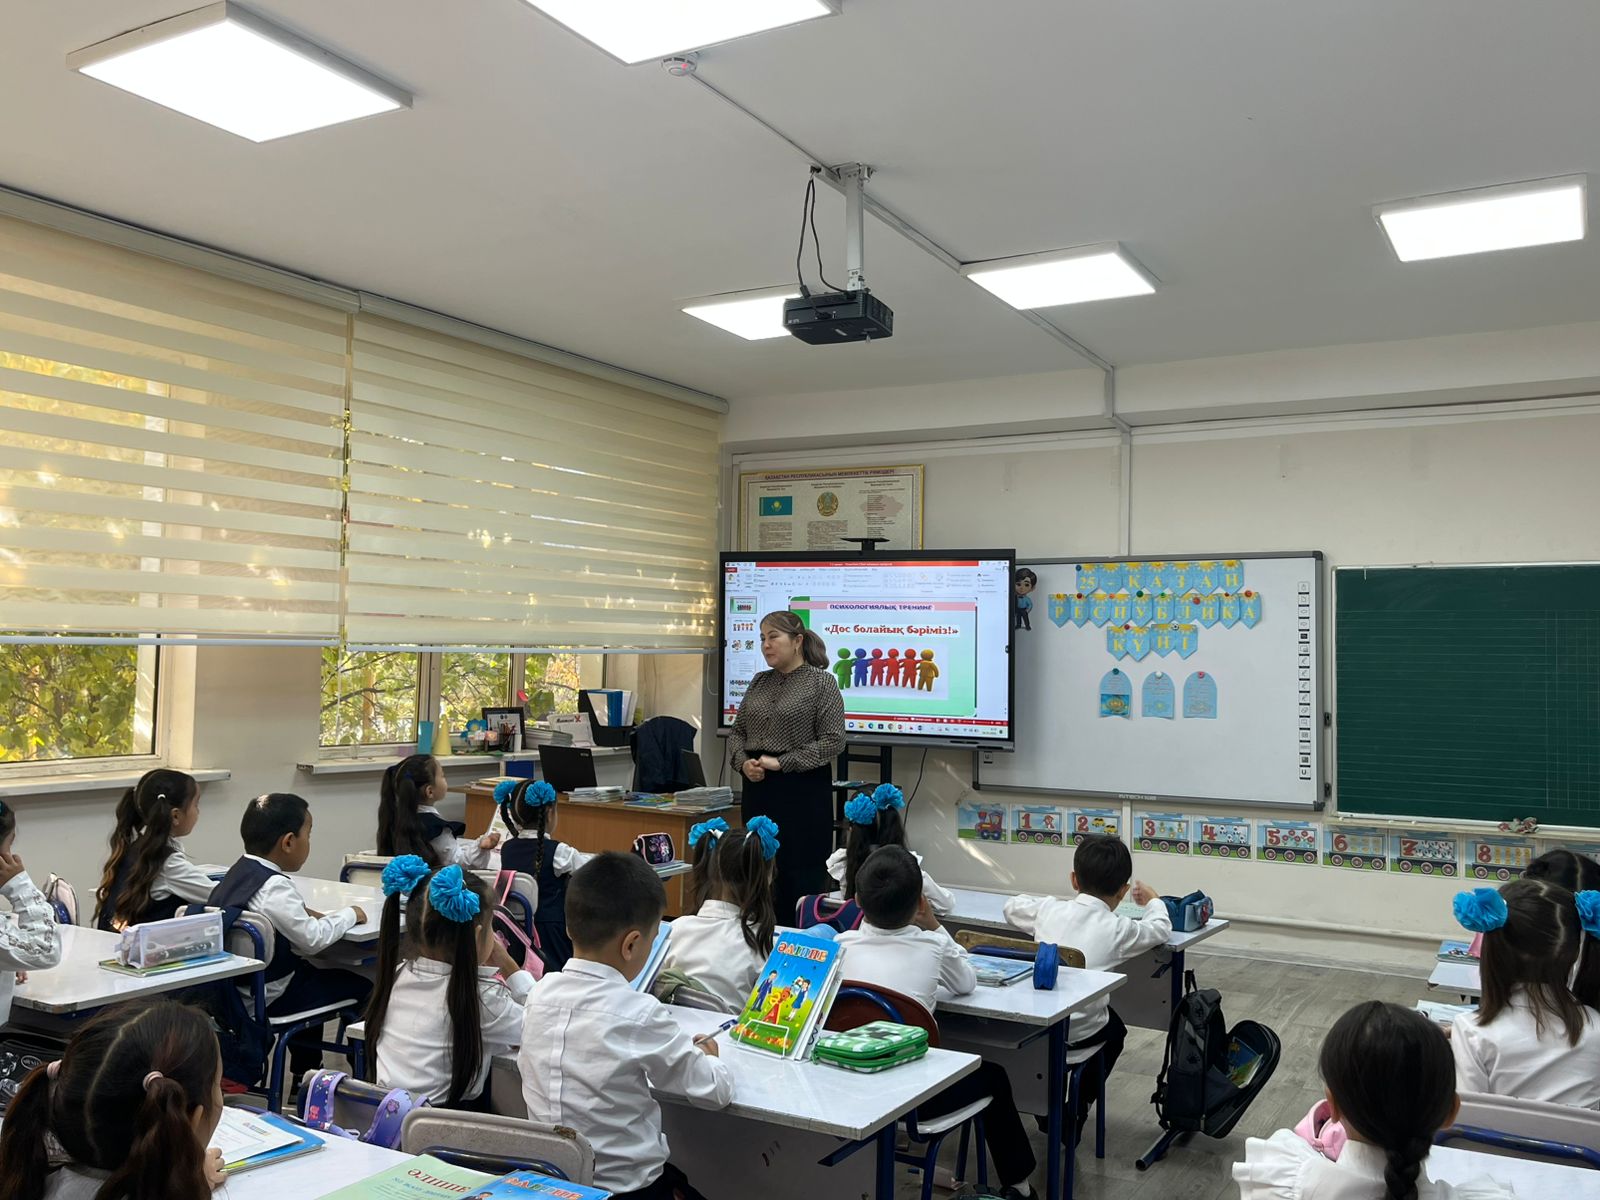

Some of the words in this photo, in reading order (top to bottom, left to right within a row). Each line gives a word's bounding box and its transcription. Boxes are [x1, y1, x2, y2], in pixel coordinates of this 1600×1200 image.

[1079, 576, 1097, 590] 25
[829, 603, 897, 611] ПСИХОЛОГИЯЛЫҚ
[1055, 604, 1257, 621] РЕСПУБЛИКА
[853, 622, 904, 636] болайық
[1022, 813, 1033, 829] 1
[1078, 815, 1089, 832] 2
[1145, 820, 1156, 836] 3
[1203, 825, 1217, 841] 4
[1267, 828, 1281, 845] 5
[1334, 834, 1348, 852] 6
[1402, 840, 1418, 856] 7
[1478, 845, 1491, 863] 8
